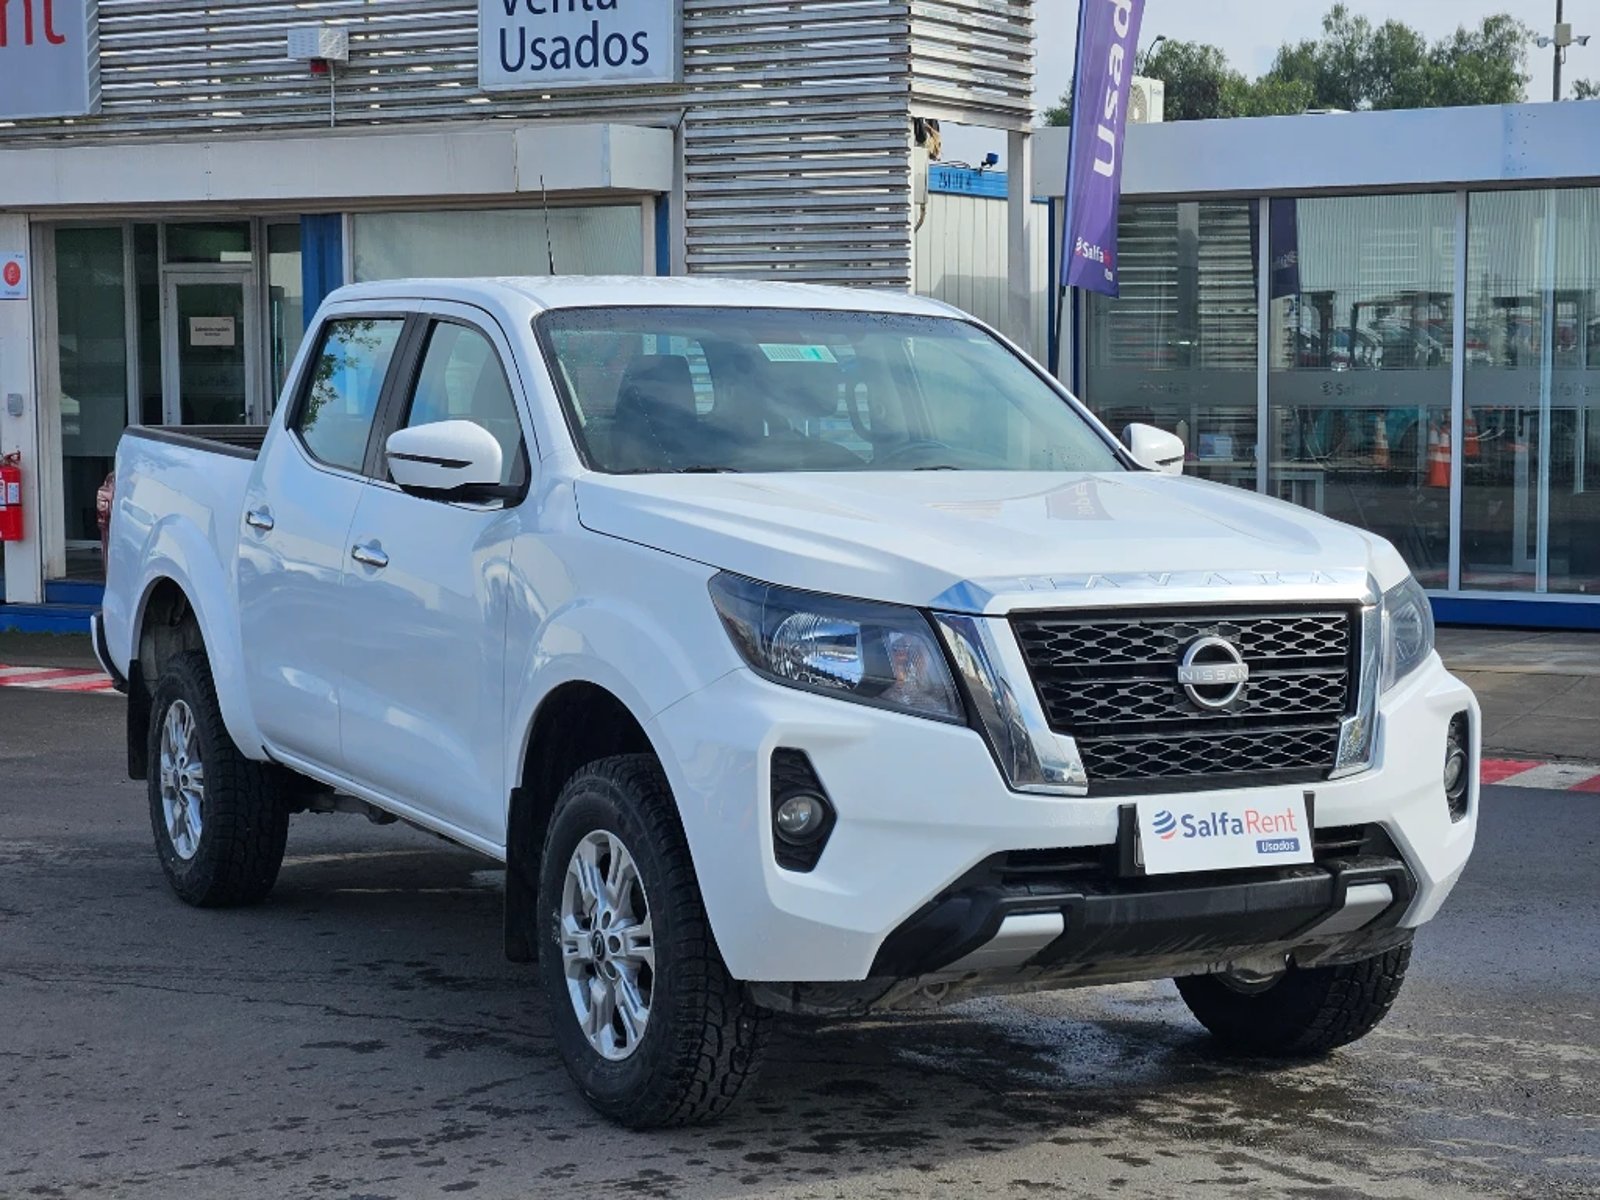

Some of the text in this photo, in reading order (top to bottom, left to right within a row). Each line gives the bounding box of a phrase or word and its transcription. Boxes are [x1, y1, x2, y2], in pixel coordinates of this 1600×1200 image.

[499, 20, 650, 73] Usados
[1180, 668, 1249, 681] NISSAN
[1180, 807, 1298, 839] SalfaRent
[1261, 840, 1296, 854] Usados
